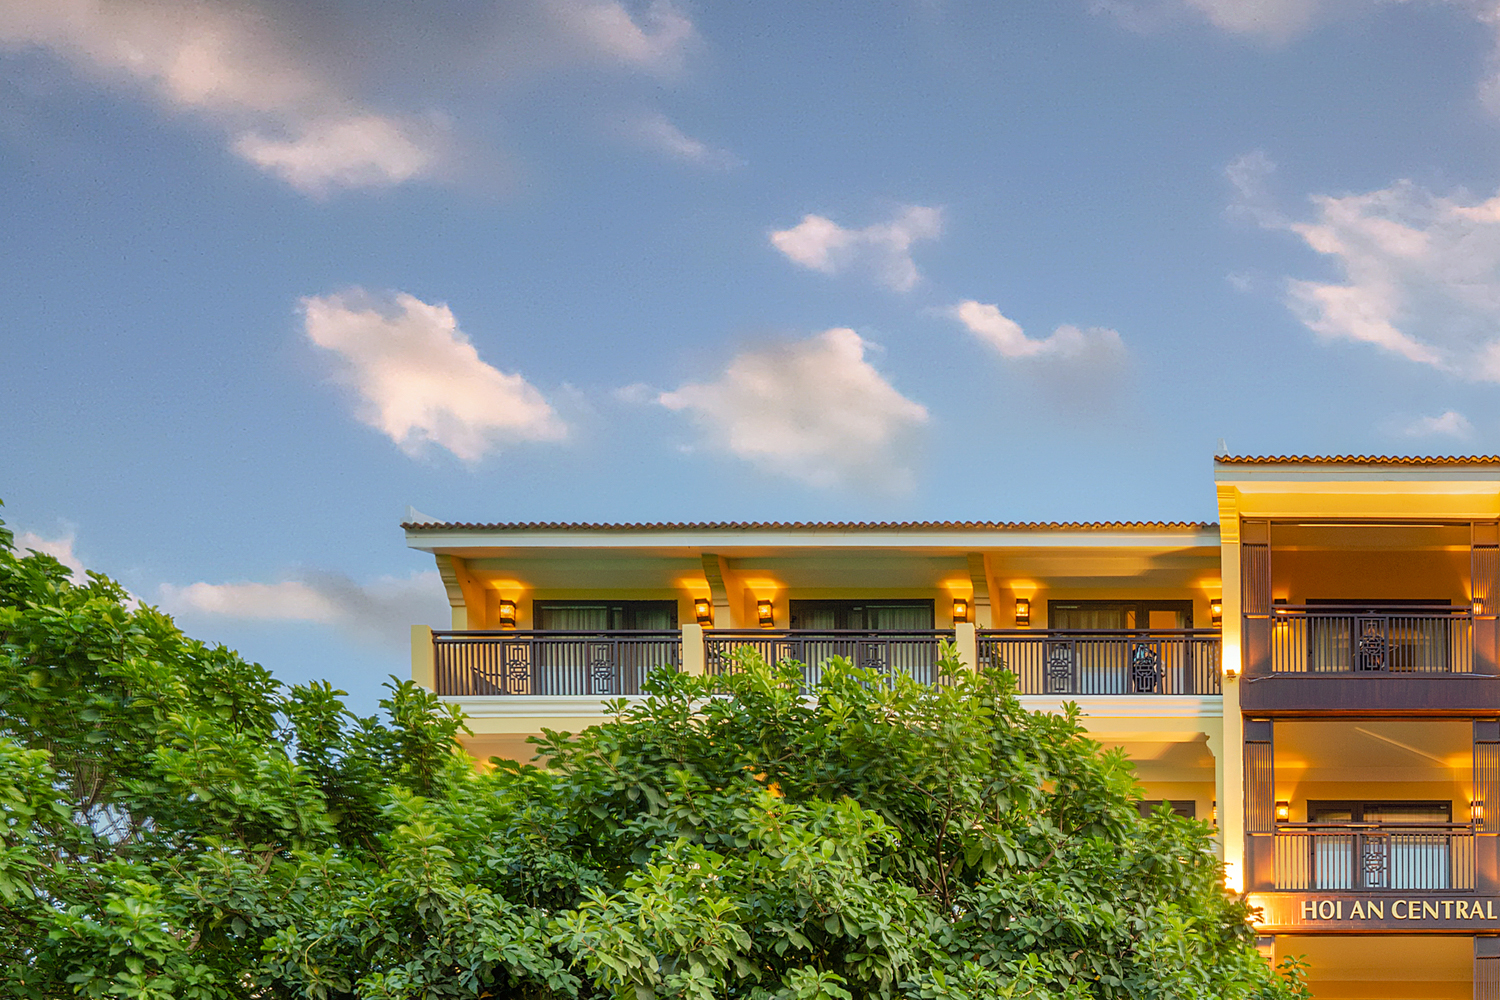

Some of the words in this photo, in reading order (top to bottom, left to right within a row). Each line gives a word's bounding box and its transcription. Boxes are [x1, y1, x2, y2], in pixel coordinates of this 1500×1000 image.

[1301, 900, 1337, 920] HOI
[1350, 900, 1385, 920] AN
[1391, 899, 1498, 920] CENTRAL
